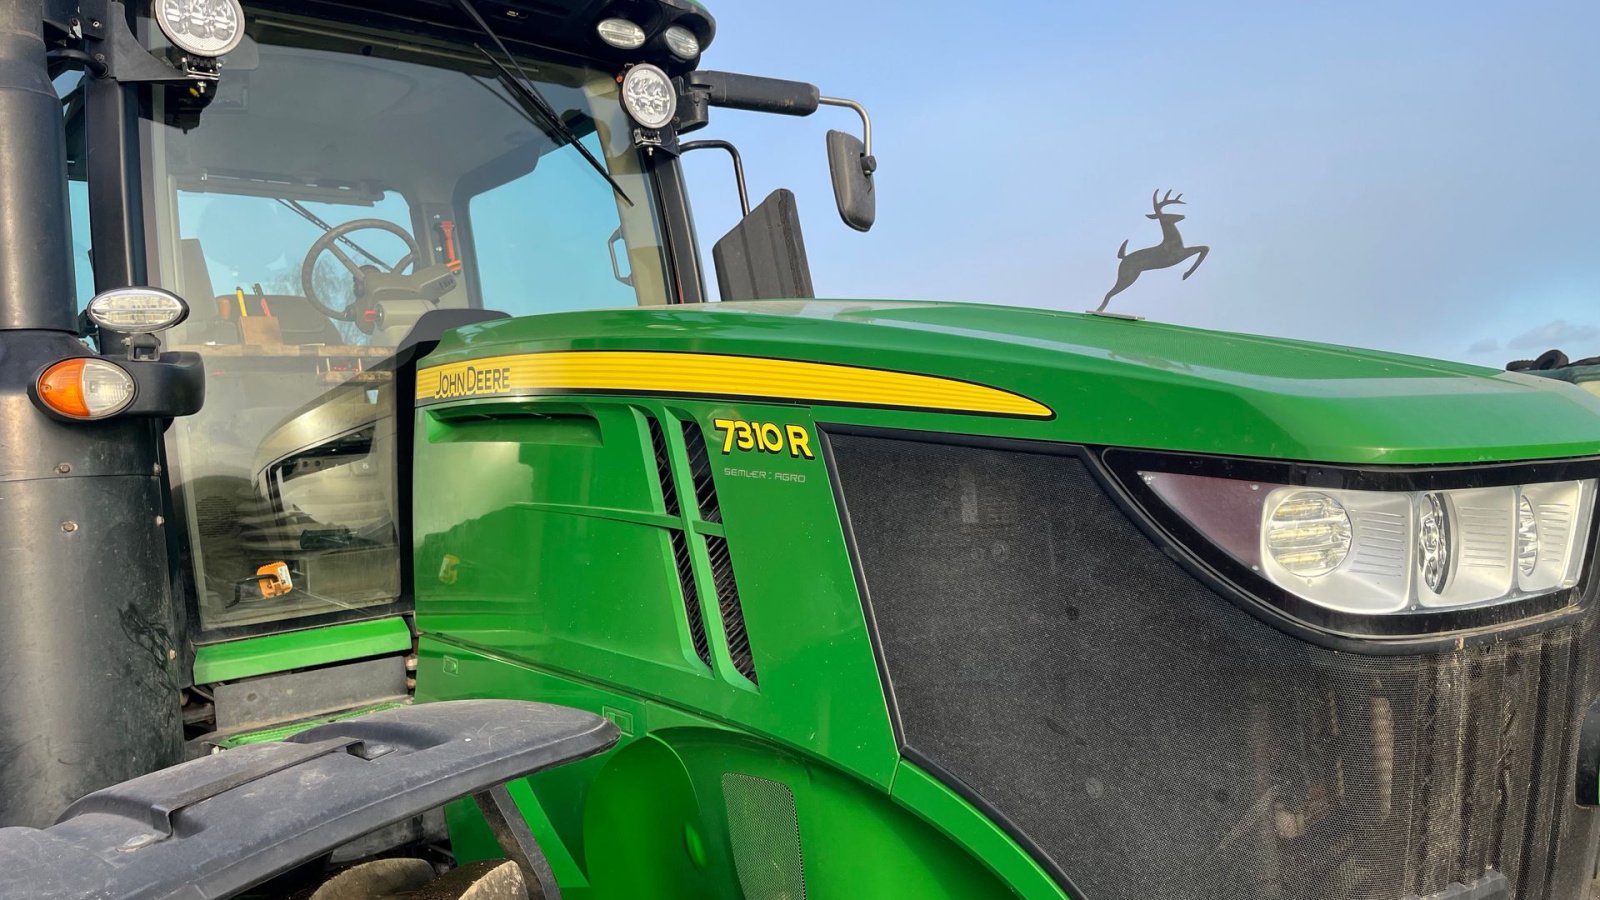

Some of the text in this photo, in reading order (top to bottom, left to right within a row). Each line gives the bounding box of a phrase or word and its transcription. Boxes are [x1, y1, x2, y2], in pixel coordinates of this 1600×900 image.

[435, 366, 511, 396] JOHN DEERE
[714, 418, 815, 460] 7310 R
[724, 467, 767, 479] SEMLER
[774, 472, 806, 483] AGRO
